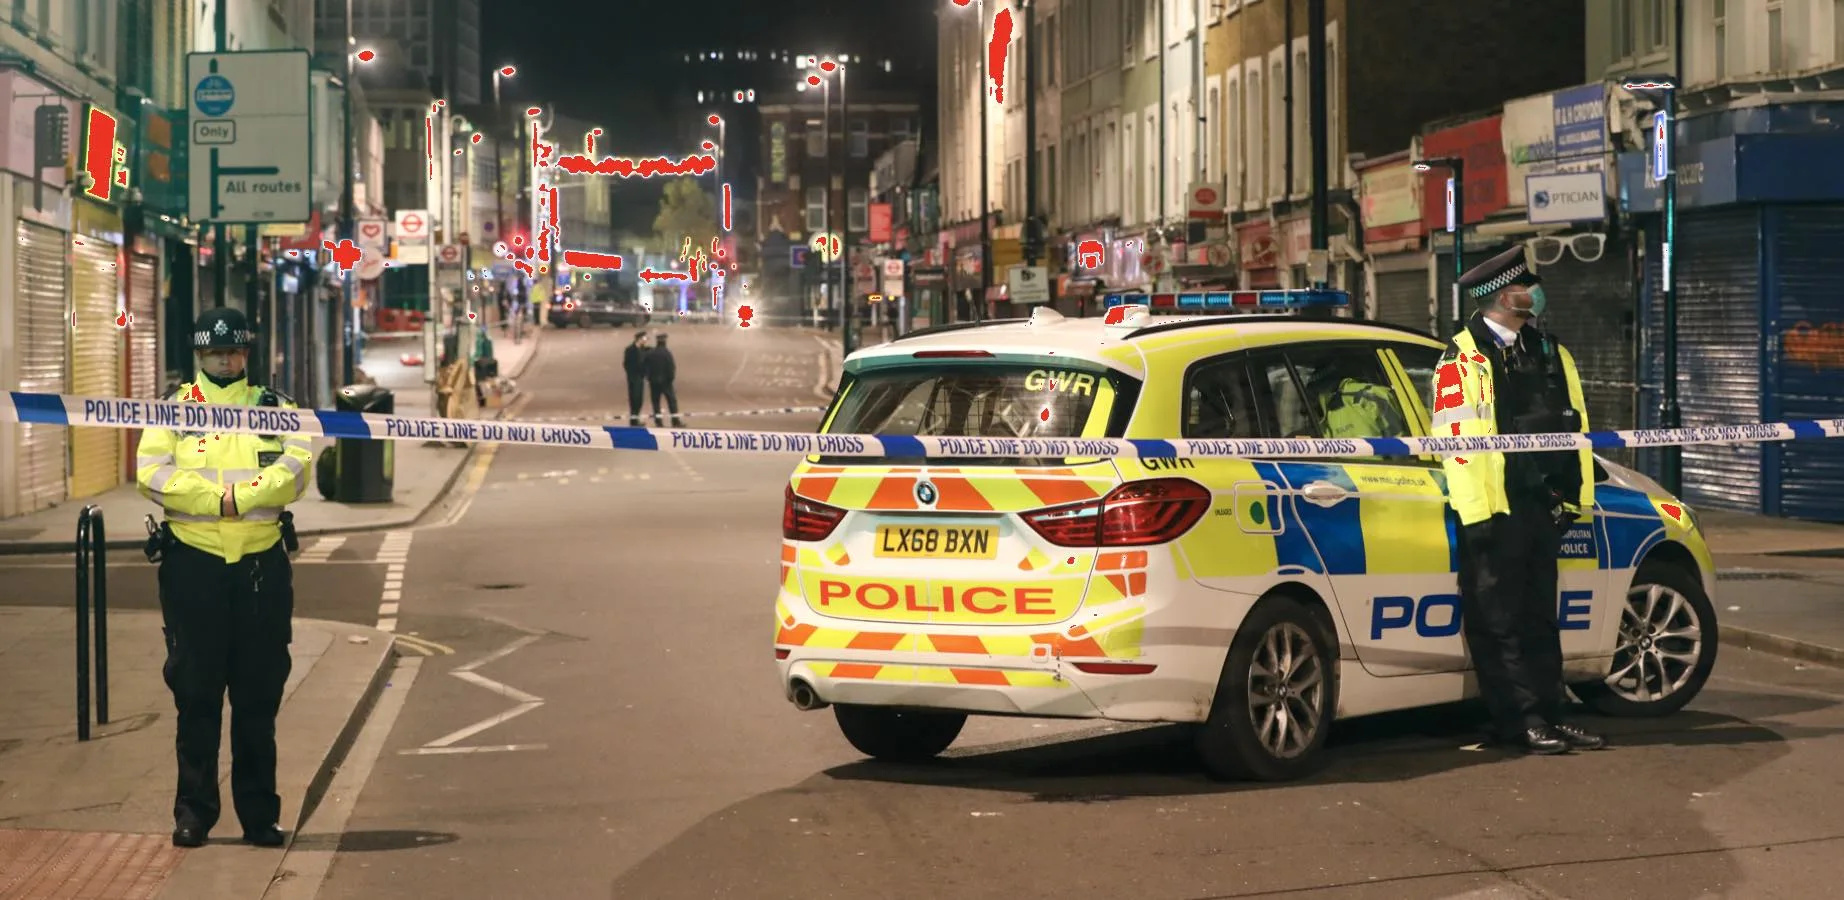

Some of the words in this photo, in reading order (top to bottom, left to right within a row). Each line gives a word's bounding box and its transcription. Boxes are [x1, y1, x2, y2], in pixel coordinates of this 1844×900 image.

[200, 126, 229, 138] Only
[226, 180, 247, 193] All
[252, 181, 301, 193] routes
[1024, 369, 1094, 397] GWR
[85, 400, 140, 424] POLICE
[146, 403, 180, 426] LINE
[185, 406, 207, 427] DO
[212, 407, 242, 429] NOT
[248, 409, 300, 432] CROSS
[385, 418, 440, 437] POLICE
[442, 421, 478, 440] LINE
[481, 424, 503, 440] DO
[508, 426, 536, 442] NOT
[541, 427, 592, 445] CROSS
[671, 431, 722, 449] POLICE
[726, 433, 758, 450] LINE
[761, 434, 782, 451] DO
[786, 434, 812, 452] NOT
[817, 435, 865, 453] CROSS
[938, 438, 987, 455] POLICE
[988, 438, 1020, 455] LINE
[1021, 439, 1042, 455] DO
[1045, 439, 1071, 455] NOT
[1073, 439, 1120, 456] CROSS
[1188, 440, 1234, 455] POLICE
[1235, 440, 1264, 455] LINE
[1266, 440, 1285, 454] DO
[1287, 440, 1312, 454] NOT
[1316, 440, 1357, 454] CROSS
[882, 528, 939, 553] LX68
[944, 529, 989, 554] BXN
[820, 580, 1056, 615] POLICE
